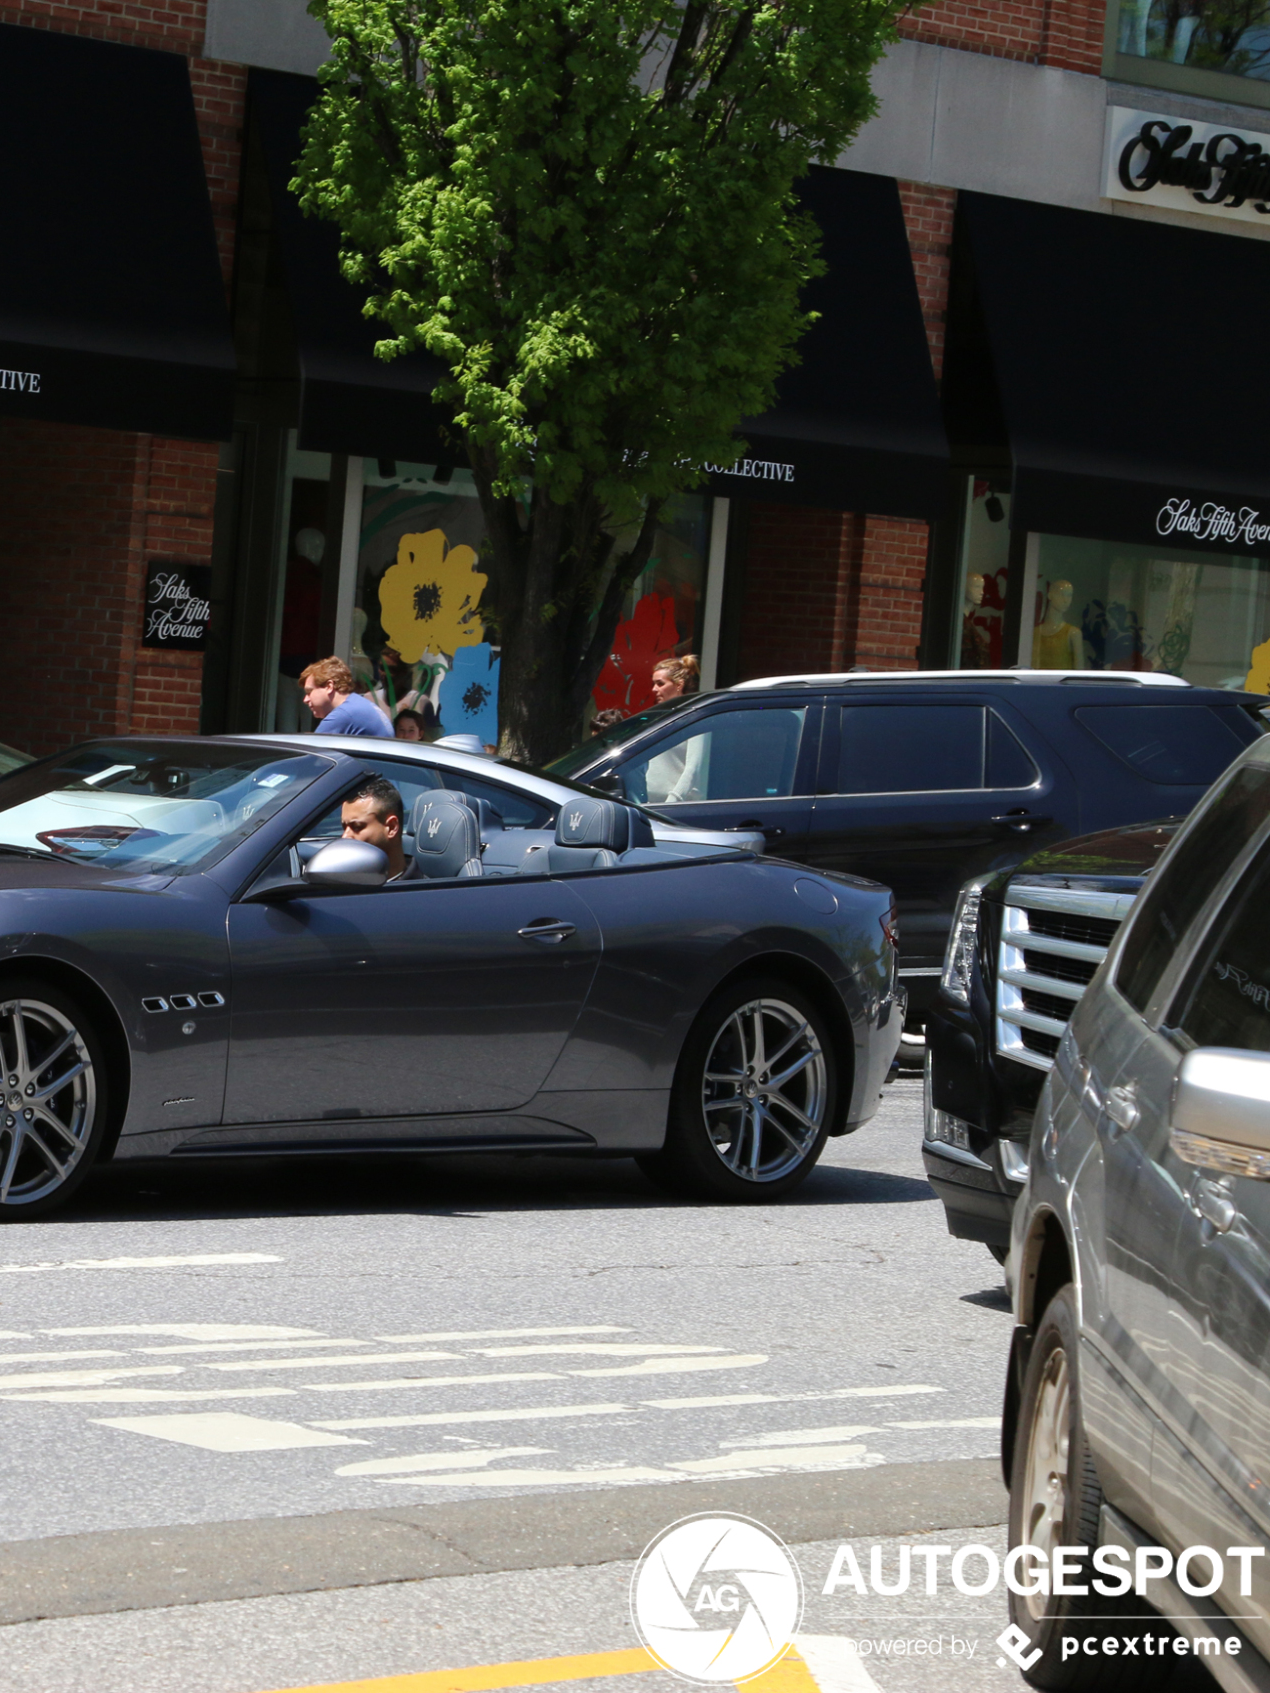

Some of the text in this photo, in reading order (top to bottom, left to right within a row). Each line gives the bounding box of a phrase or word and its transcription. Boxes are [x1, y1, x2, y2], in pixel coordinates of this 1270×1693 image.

[1156, 498, 1202, 536] Saks
[1194, 502, 1237, 541] Fifth
[148, 572, 191, 604] Saks
[145, 609, 204, 640] Avenue
[168, 597, 210, 624] Fifth
